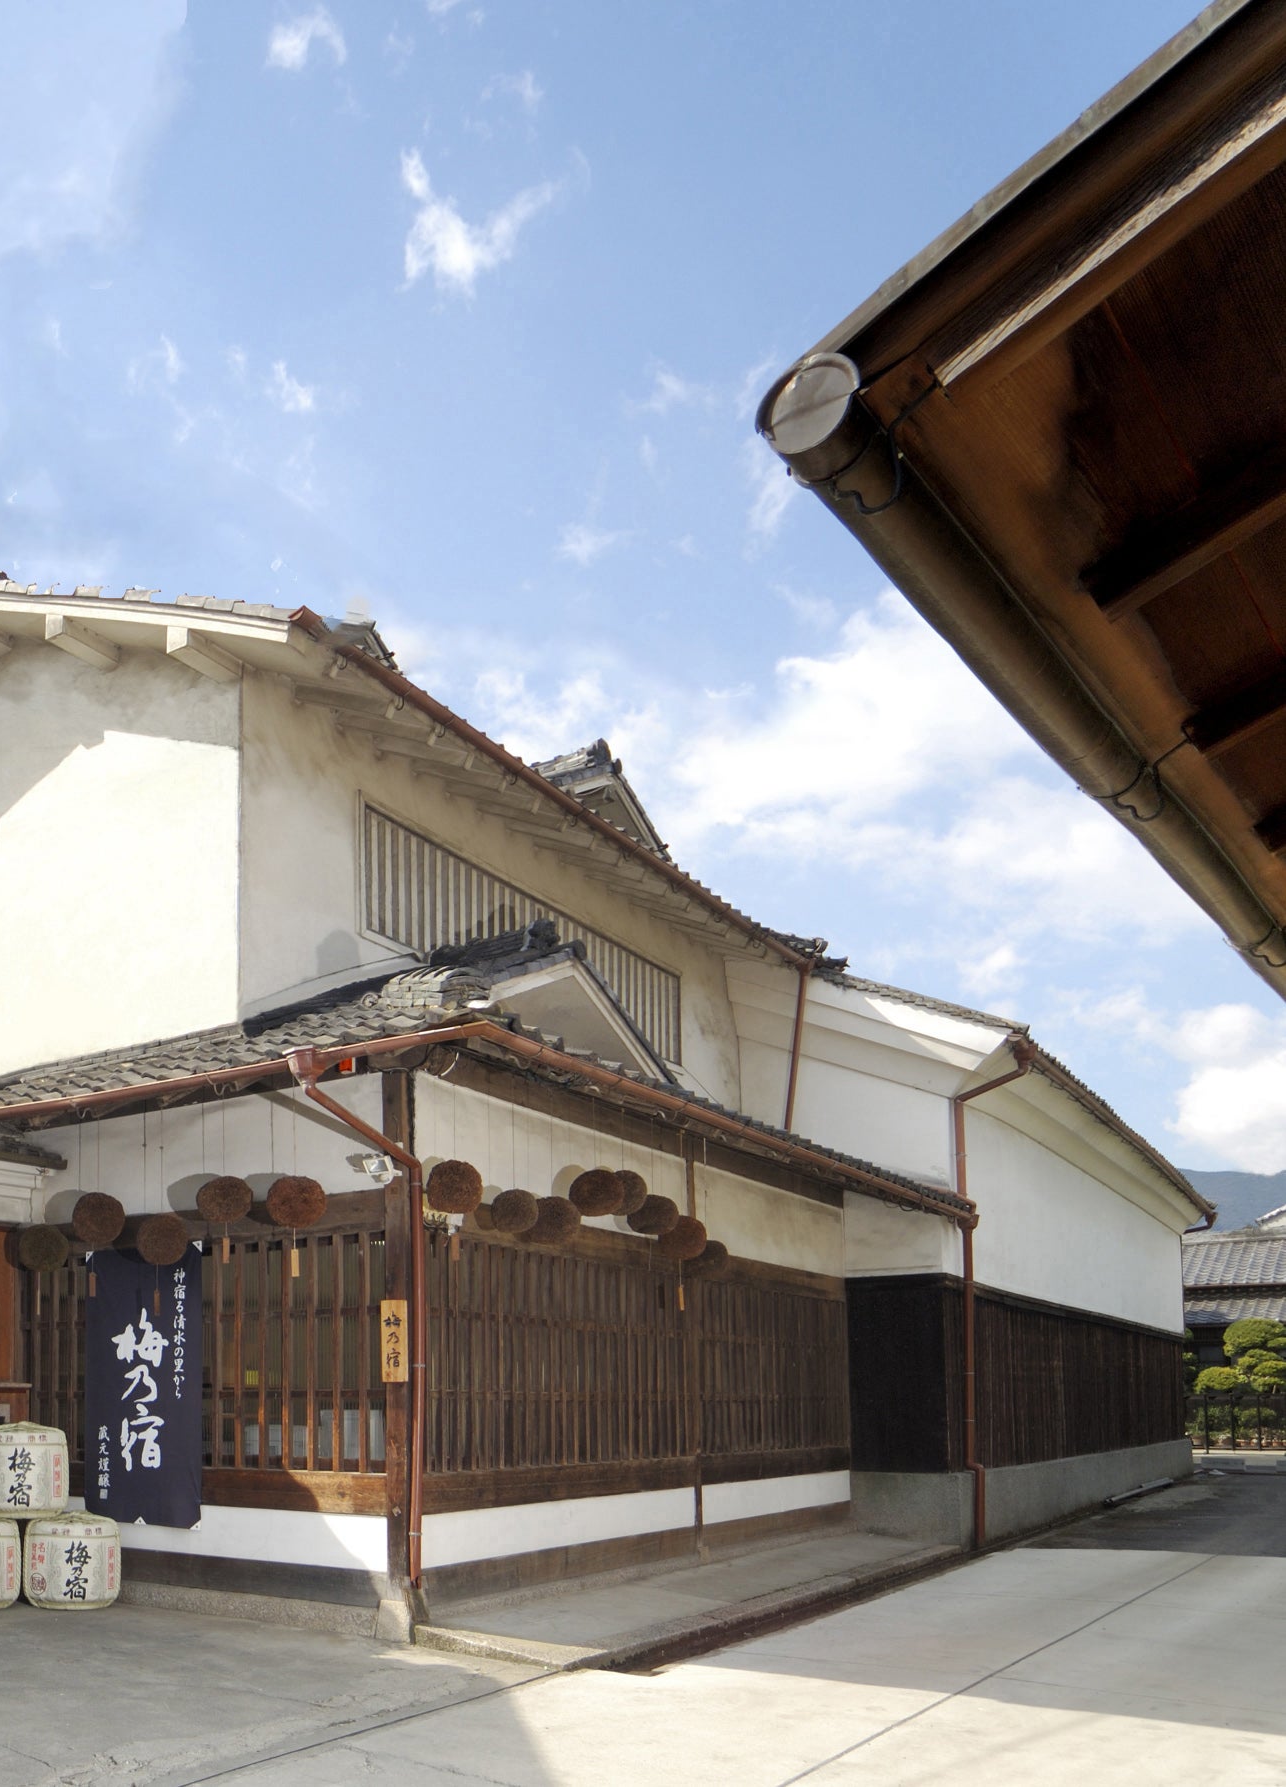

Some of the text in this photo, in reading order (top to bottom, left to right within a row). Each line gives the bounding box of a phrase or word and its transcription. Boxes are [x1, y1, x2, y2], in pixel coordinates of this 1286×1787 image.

[173, 1267, 187, 1400] 神宿る清水の里から
[383, 1310, 402, 1368] 梅乃宿
[111, 1307, 170, 1472] 梅乃宿
[7, 1447, 36, 1507] 梅乃宿
[63, 1540, 92, 1600] 梅乃宿
